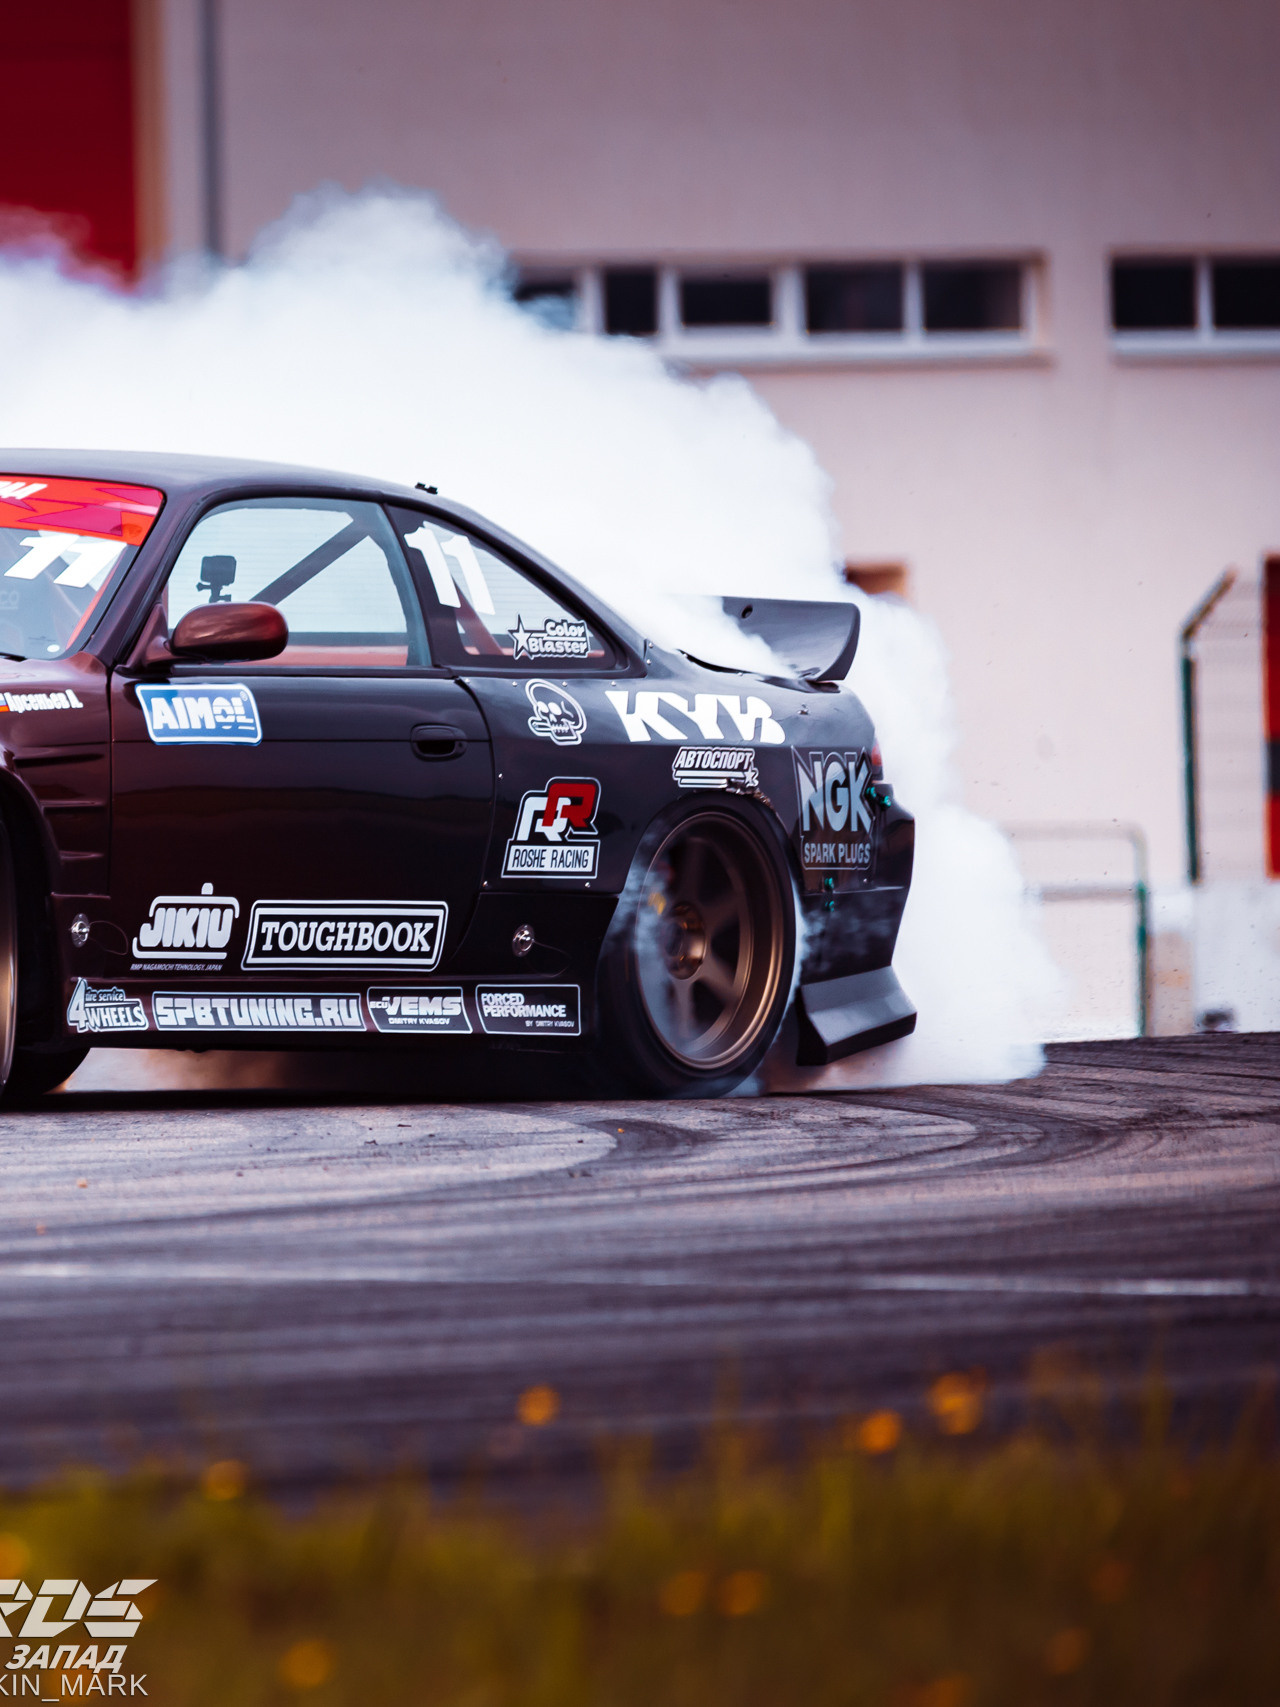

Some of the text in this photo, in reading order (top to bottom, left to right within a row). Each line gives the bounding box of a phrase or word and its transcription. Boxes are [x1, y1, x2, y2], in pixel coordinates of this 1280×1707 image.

[3, 533, 127, 588] 11
[404, 526, 495, 616] 11
[545, 621, 585, 637] Color
[528, 637, 588, 654] Blaster
[151, 695, 255, 731] AIMOL
[605, 691, 785, 744] KYB
[675, 750, 753, 770] АВТОСПОРТ
[795, 751, 874, 832] NGK
[512, 849, 590, 868] ROSHE RACING
[804, 842, 871, 865] SPARK PLUGS
[139, 907, 234, 949] JIKIU
[260, 920, 434, 953] TOUGHBOOK
[205, 964, 223, 972] JAPAN
[70, 977, 88, 1030] 4
[98, 990, 125, 1002] service
[382, 996, 463, 1016] VEMS
[481, 993, 524, 1006] FORCED
[85, 1006, 145, 1029] WHEELS
[156, 997, 361, 1027] SPBTUNING.RU
[388, 1017, 451, 1025] DMITRY KVASOV
[483, 1004, 567, 1018] PERFORMANCE
